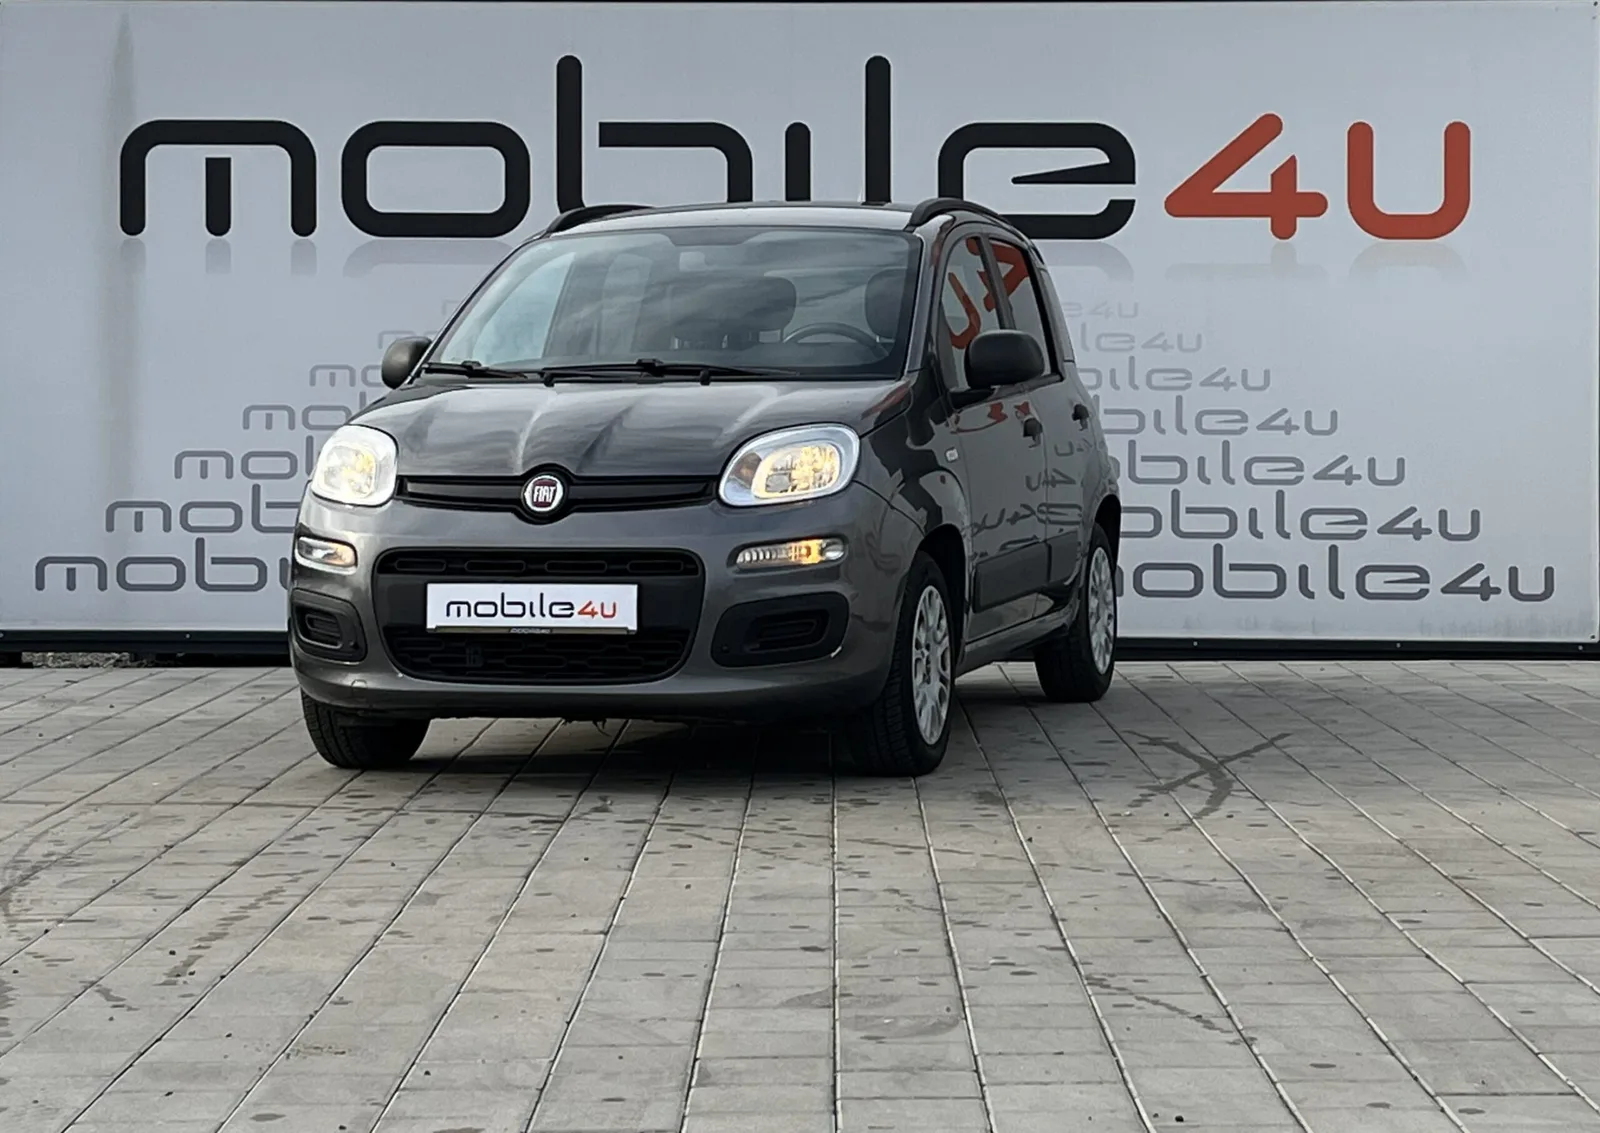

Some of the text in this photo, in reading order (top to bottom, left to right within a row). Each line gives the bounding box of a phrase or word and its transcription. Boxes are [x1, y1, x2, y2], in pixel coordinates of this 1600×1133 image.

[1110, 440, 1406, 486] bile4u
[533, 486, 556, 502] FIAT
[1121, 488, 1481, 542] obile4u
[1117, 543, 1555, 602] obile4u
[446, 592, 617, 619] mobile4u
